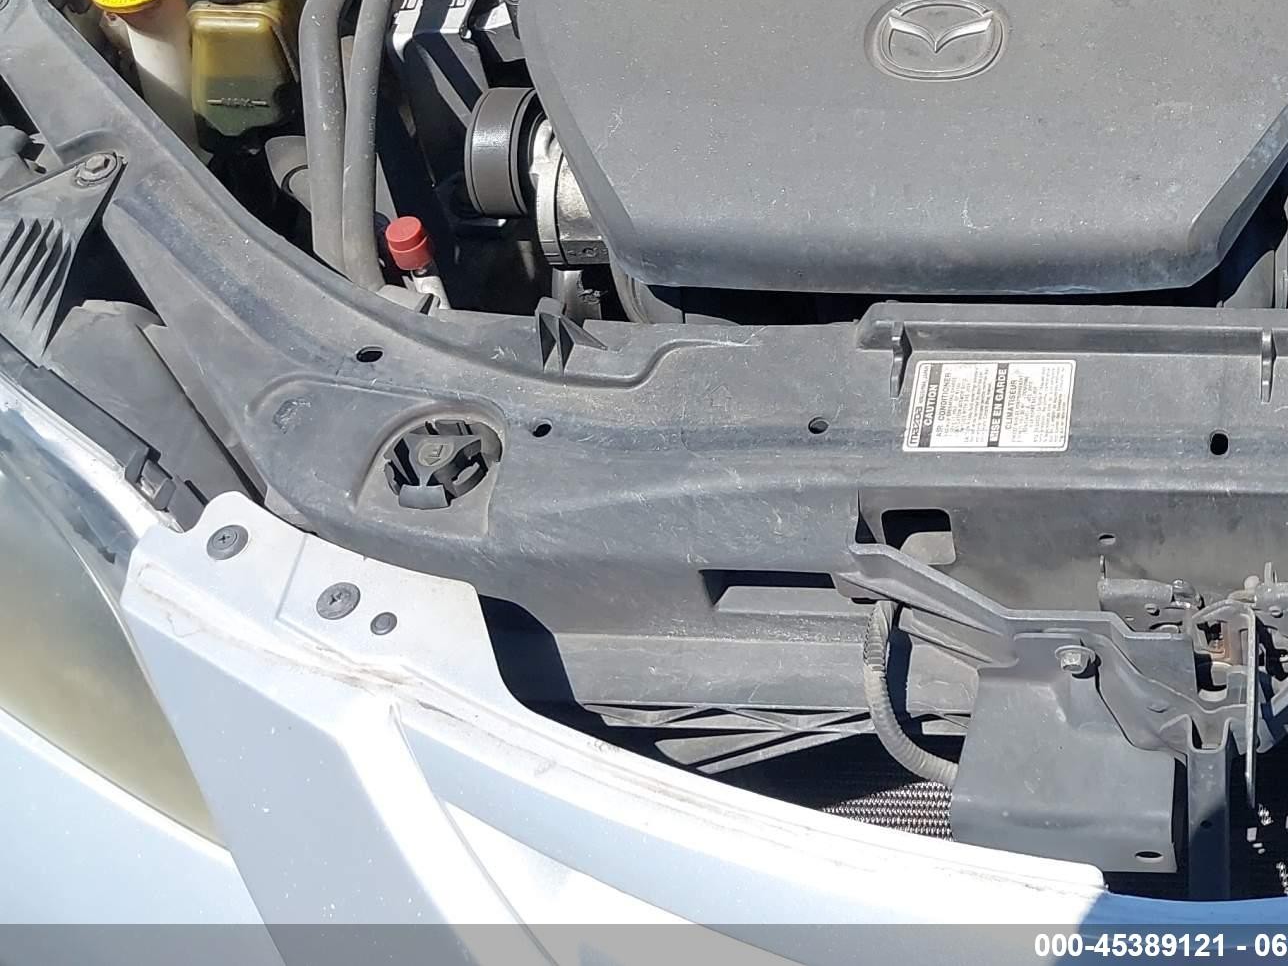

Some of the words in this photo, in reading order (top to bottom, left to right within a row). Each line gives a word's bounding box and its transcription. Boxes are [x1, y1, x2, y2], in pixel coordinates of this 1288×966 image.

[923, 384, 939, 427] CAUTION
[938, 372, 952, 421] CONDITIONER
[994, 368, 1008, 402] GARDE
[1005, 379, 1018, 430] CLIMATISEUR
[993, 403, 1003, 417] EN
